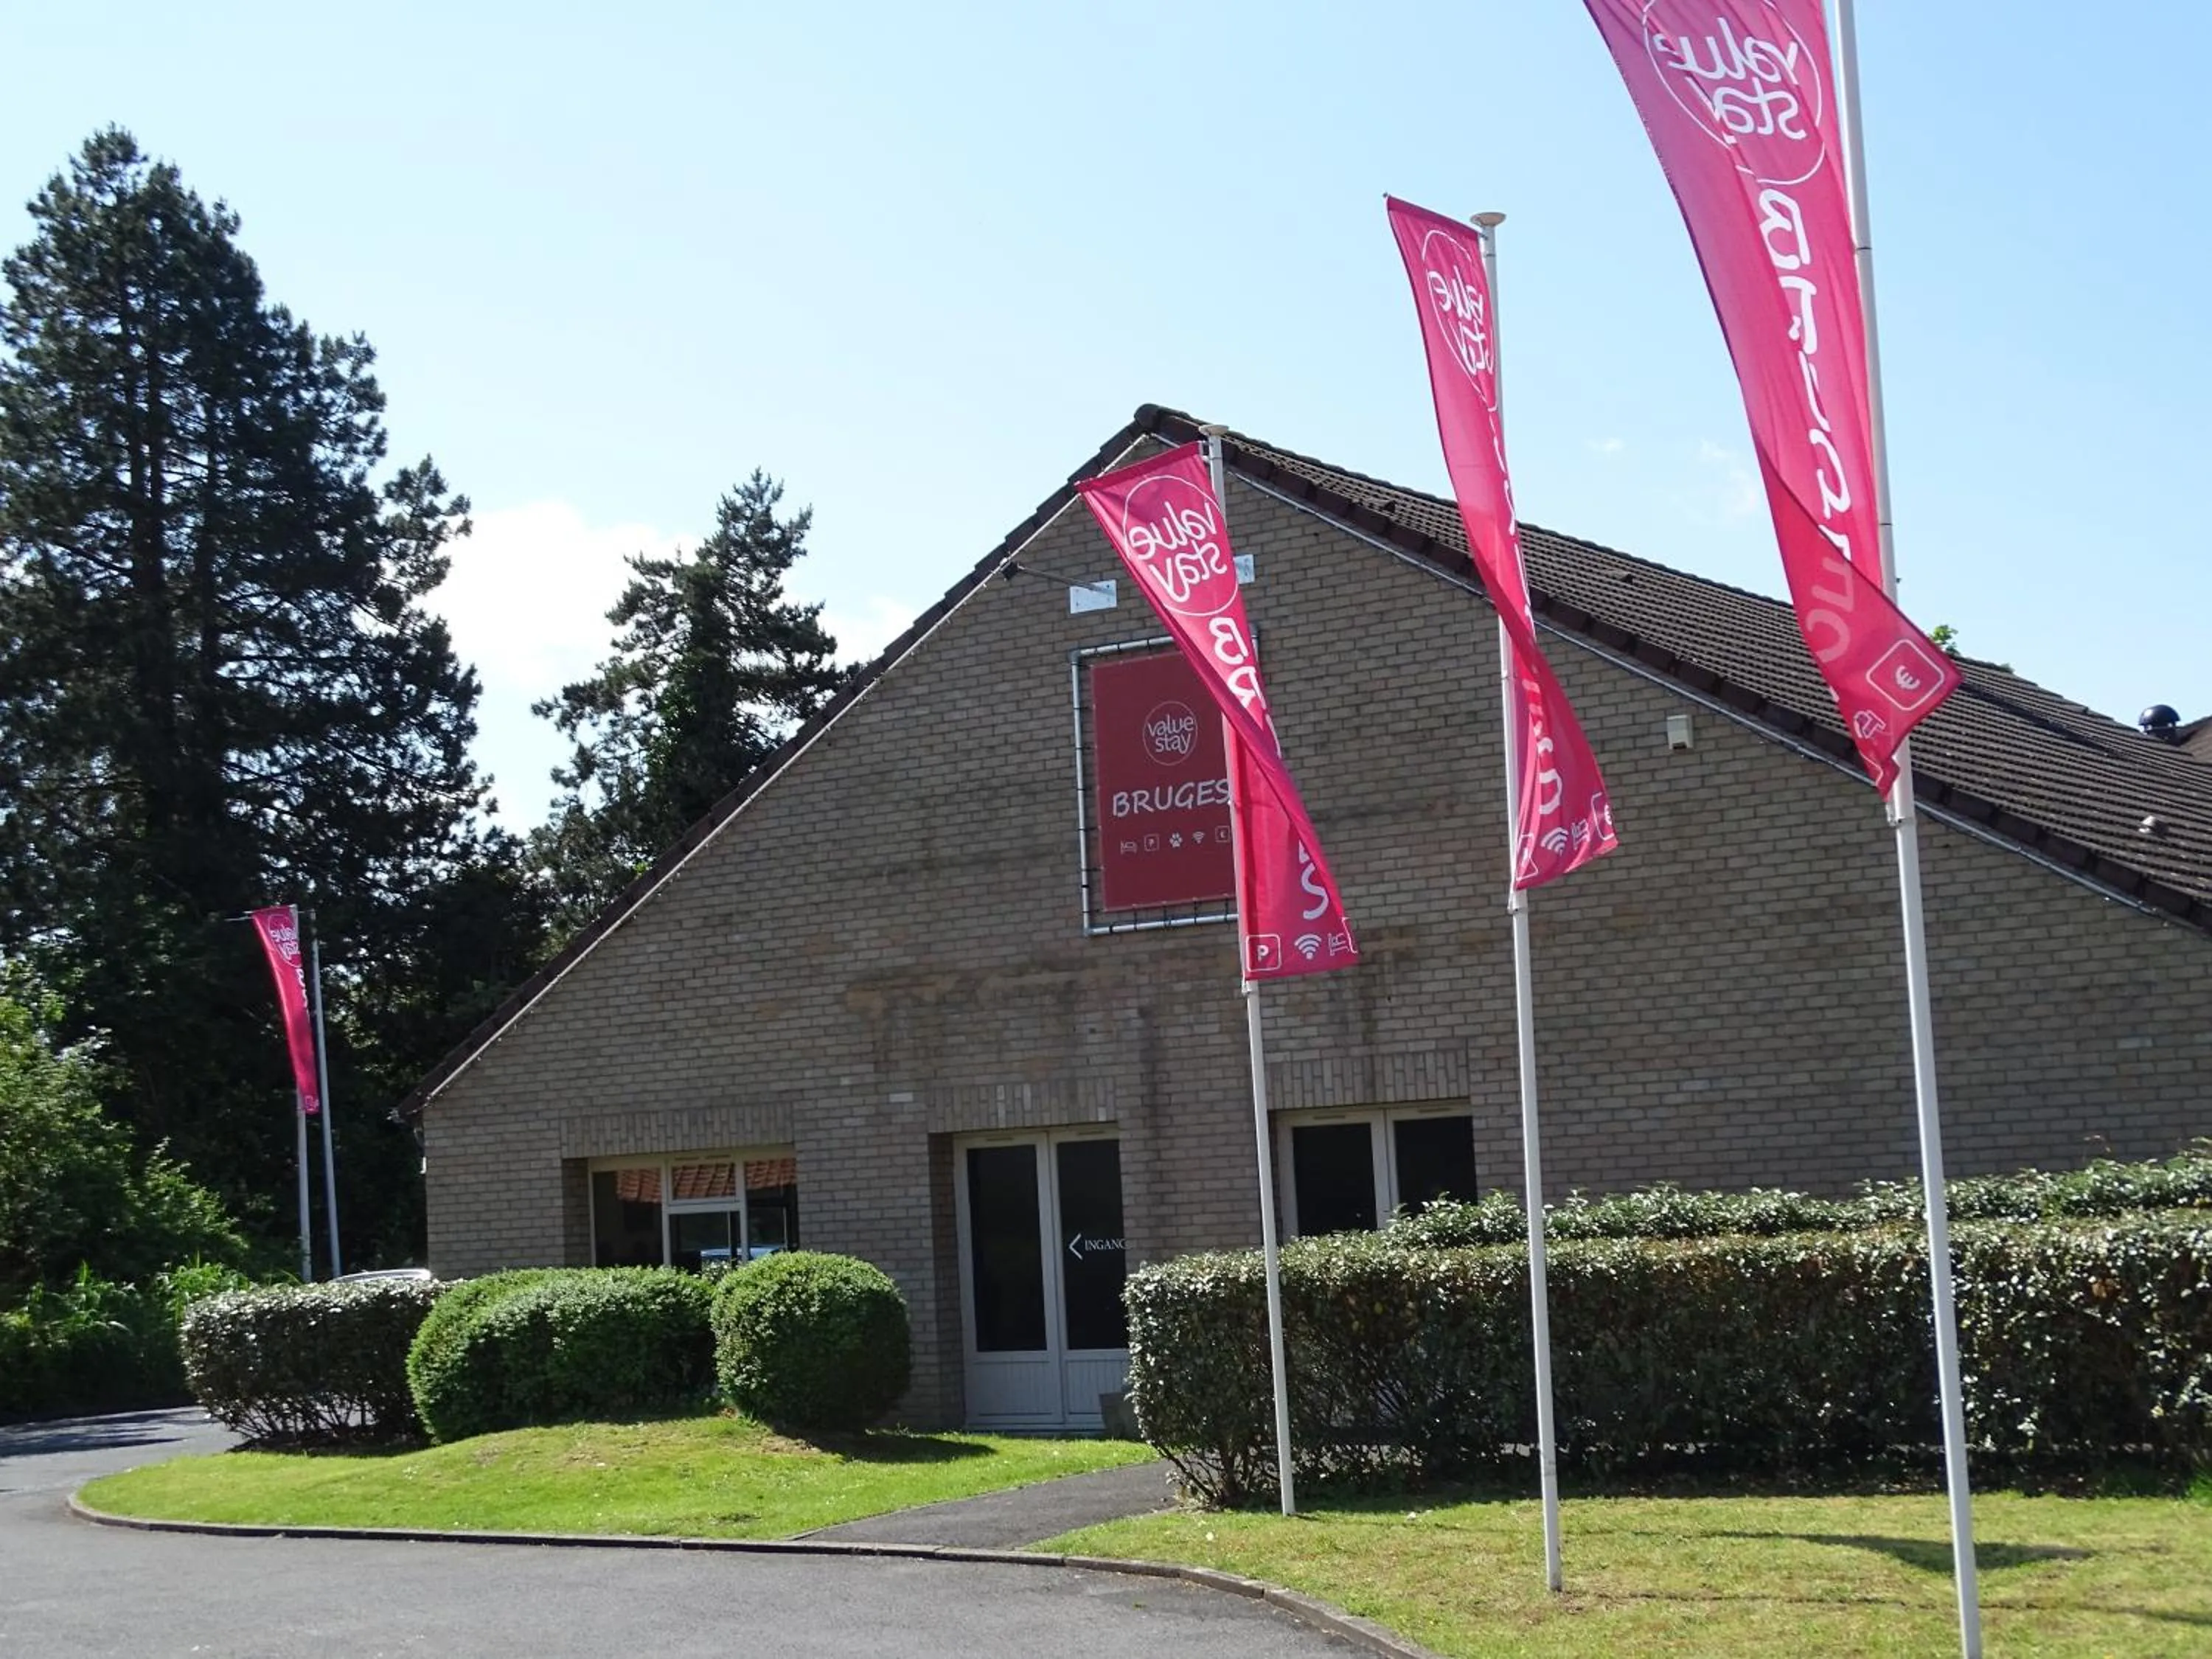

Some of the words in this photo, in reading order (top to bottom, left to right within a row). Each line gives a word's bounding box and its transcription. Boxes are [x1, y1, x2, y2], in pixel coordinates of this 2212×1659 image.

[1147, 714, 1194, 737] value
[1155, 733, 1192, 755] stay
[1113, 778, 1230, 818] BRUGES
